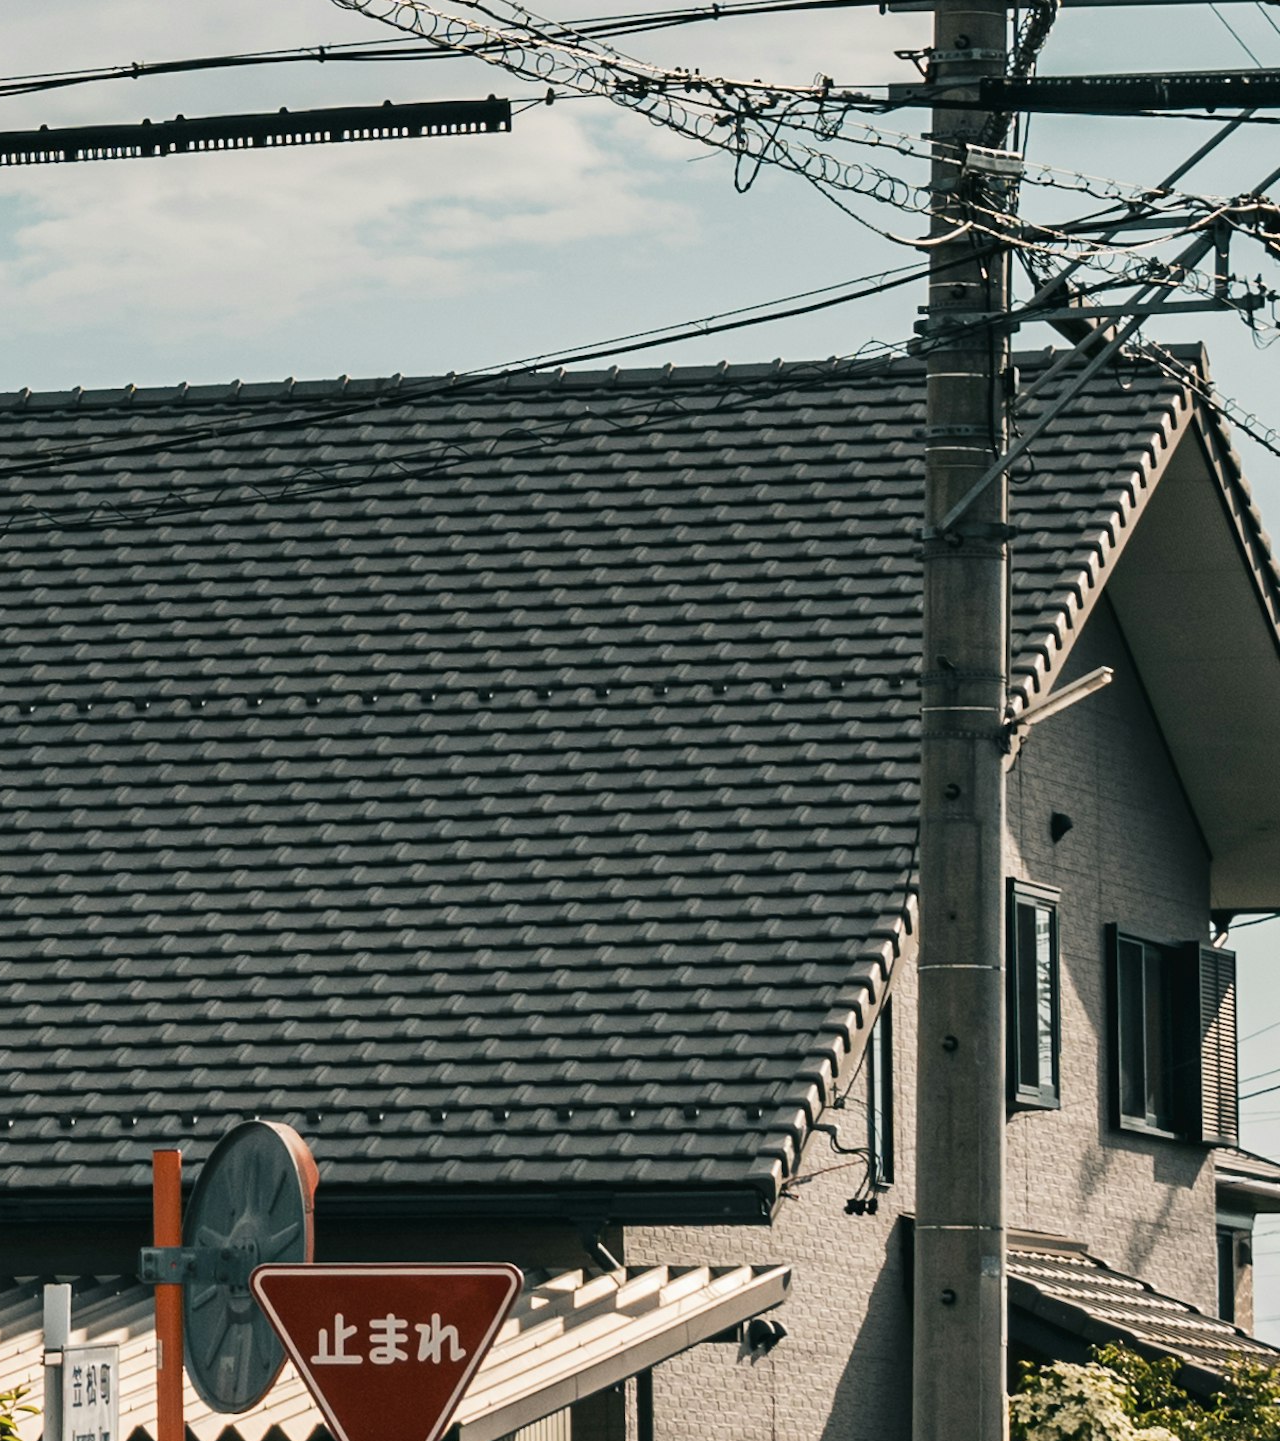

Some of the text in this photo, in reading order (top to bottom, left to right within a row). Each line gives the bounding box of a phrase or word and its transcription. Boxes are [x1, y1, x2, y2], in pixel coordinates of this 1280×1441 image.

[310, 1312, 467, 1365] 止まれ
[72, 1363, 111, 1407] 笠松町
